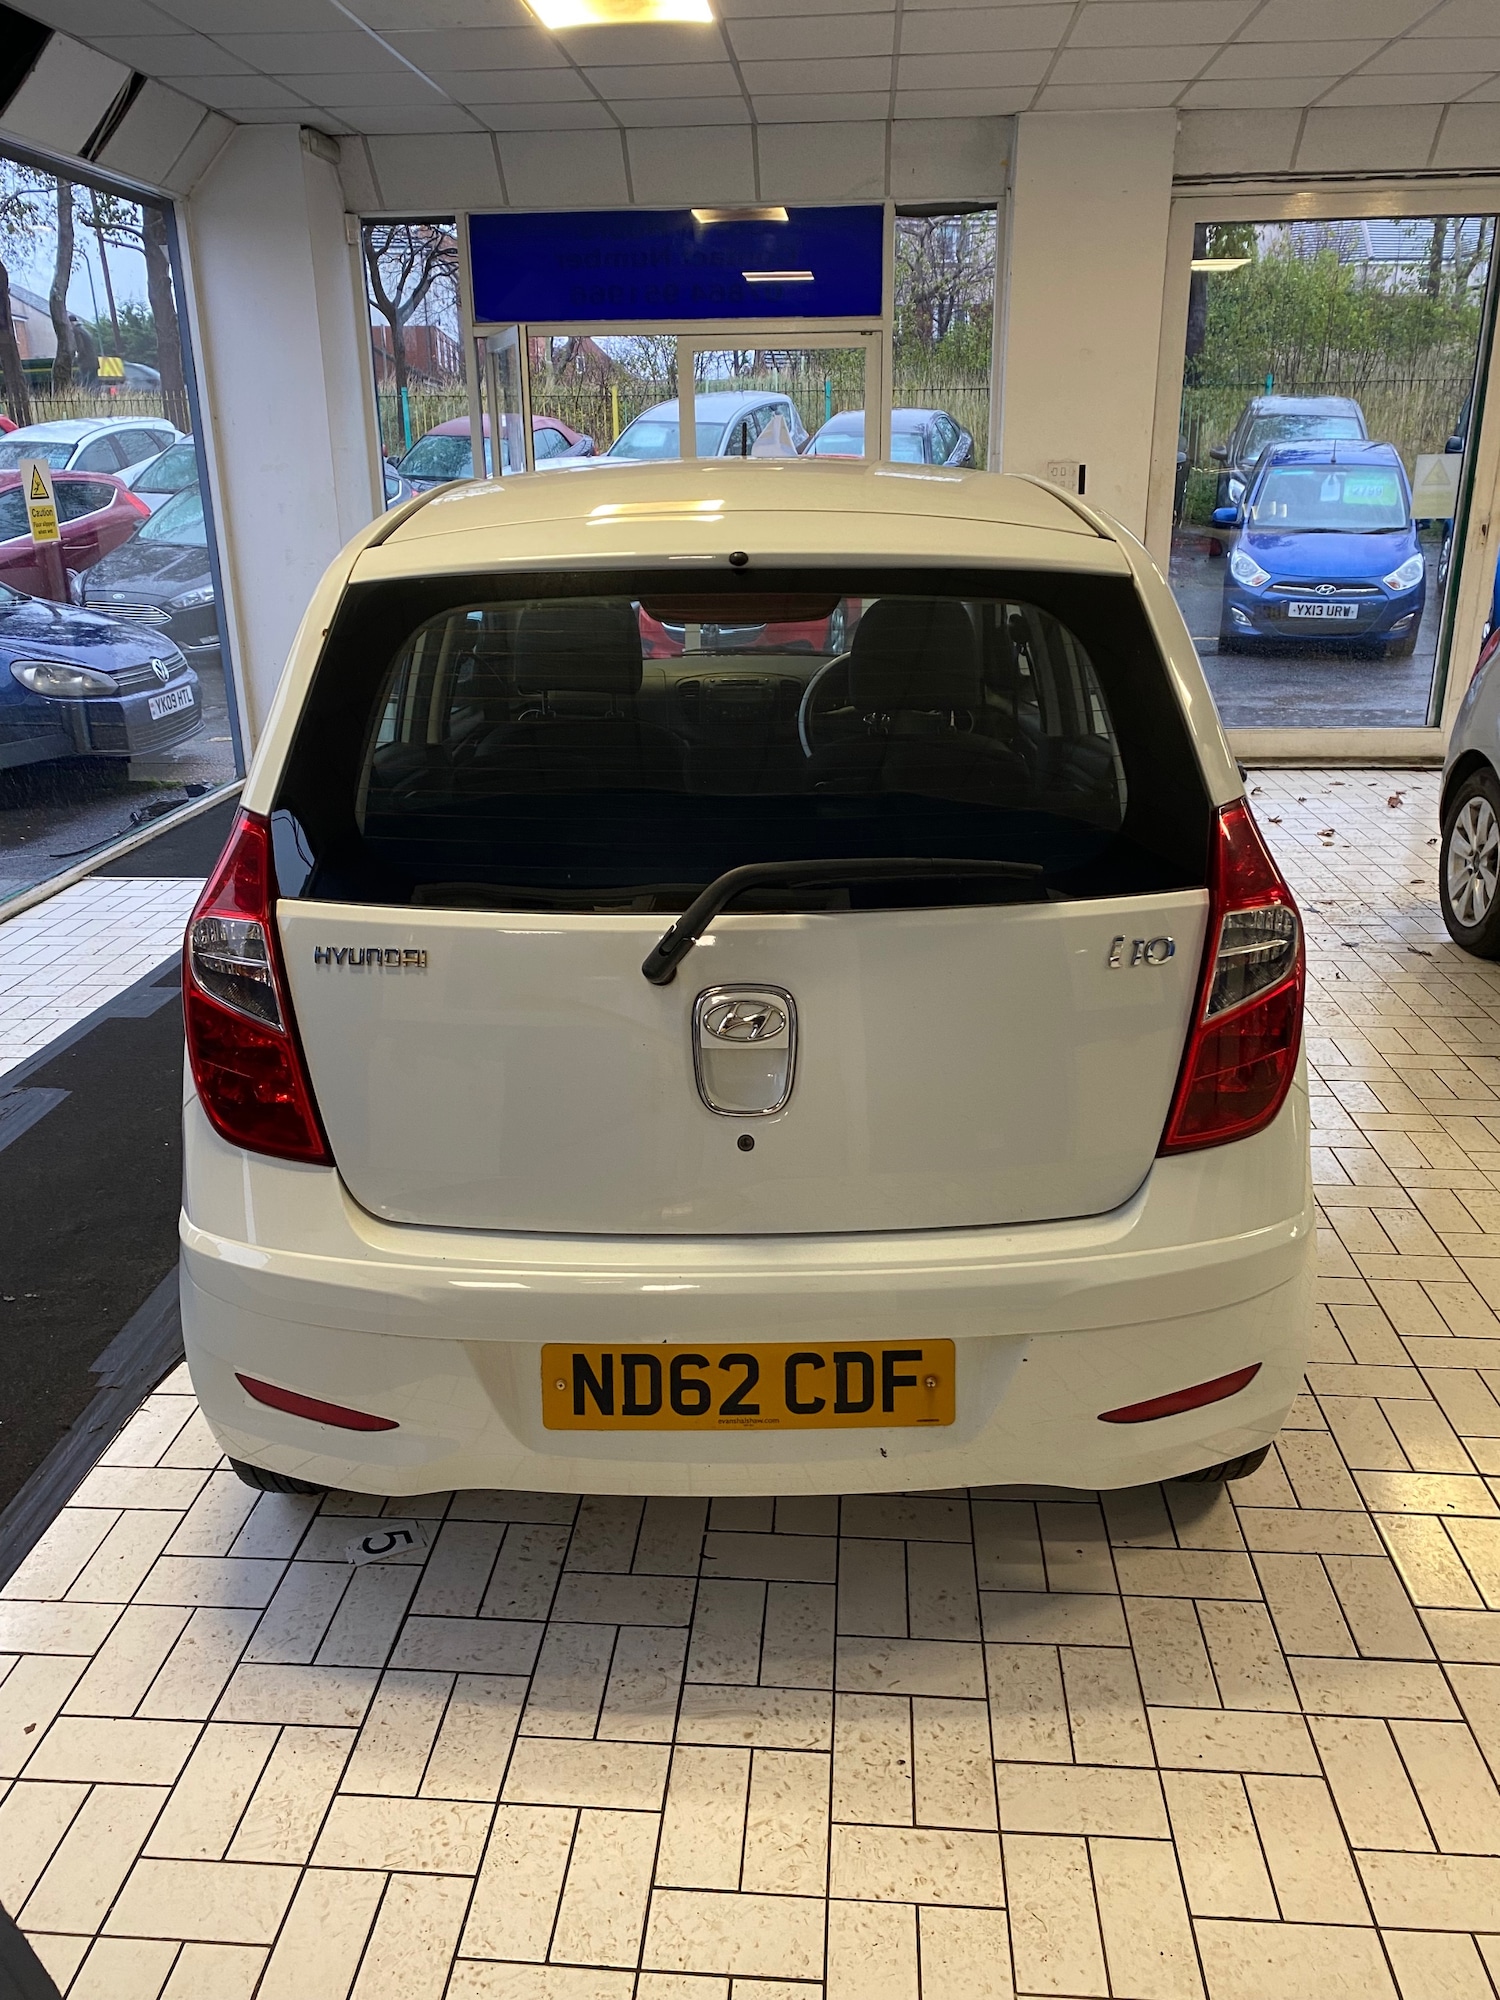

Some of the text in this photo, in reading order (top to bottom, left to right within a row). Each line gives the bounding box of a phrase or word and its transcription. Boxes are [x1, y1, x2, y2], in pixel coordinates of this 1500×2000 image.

[31, 507, 54, 518] Caution
[1297, 604, 1351, 617] YX13 URW
[155, 688, 192, 714] YK09 HTL
[314, 945, 428, 968] HYUNDAI
[571, 1350, 923, 1416] ND62 CDF
[717, 1417, 780, 1425] evanshalshaw.com
[362, 1530, 414, 1555] 5
